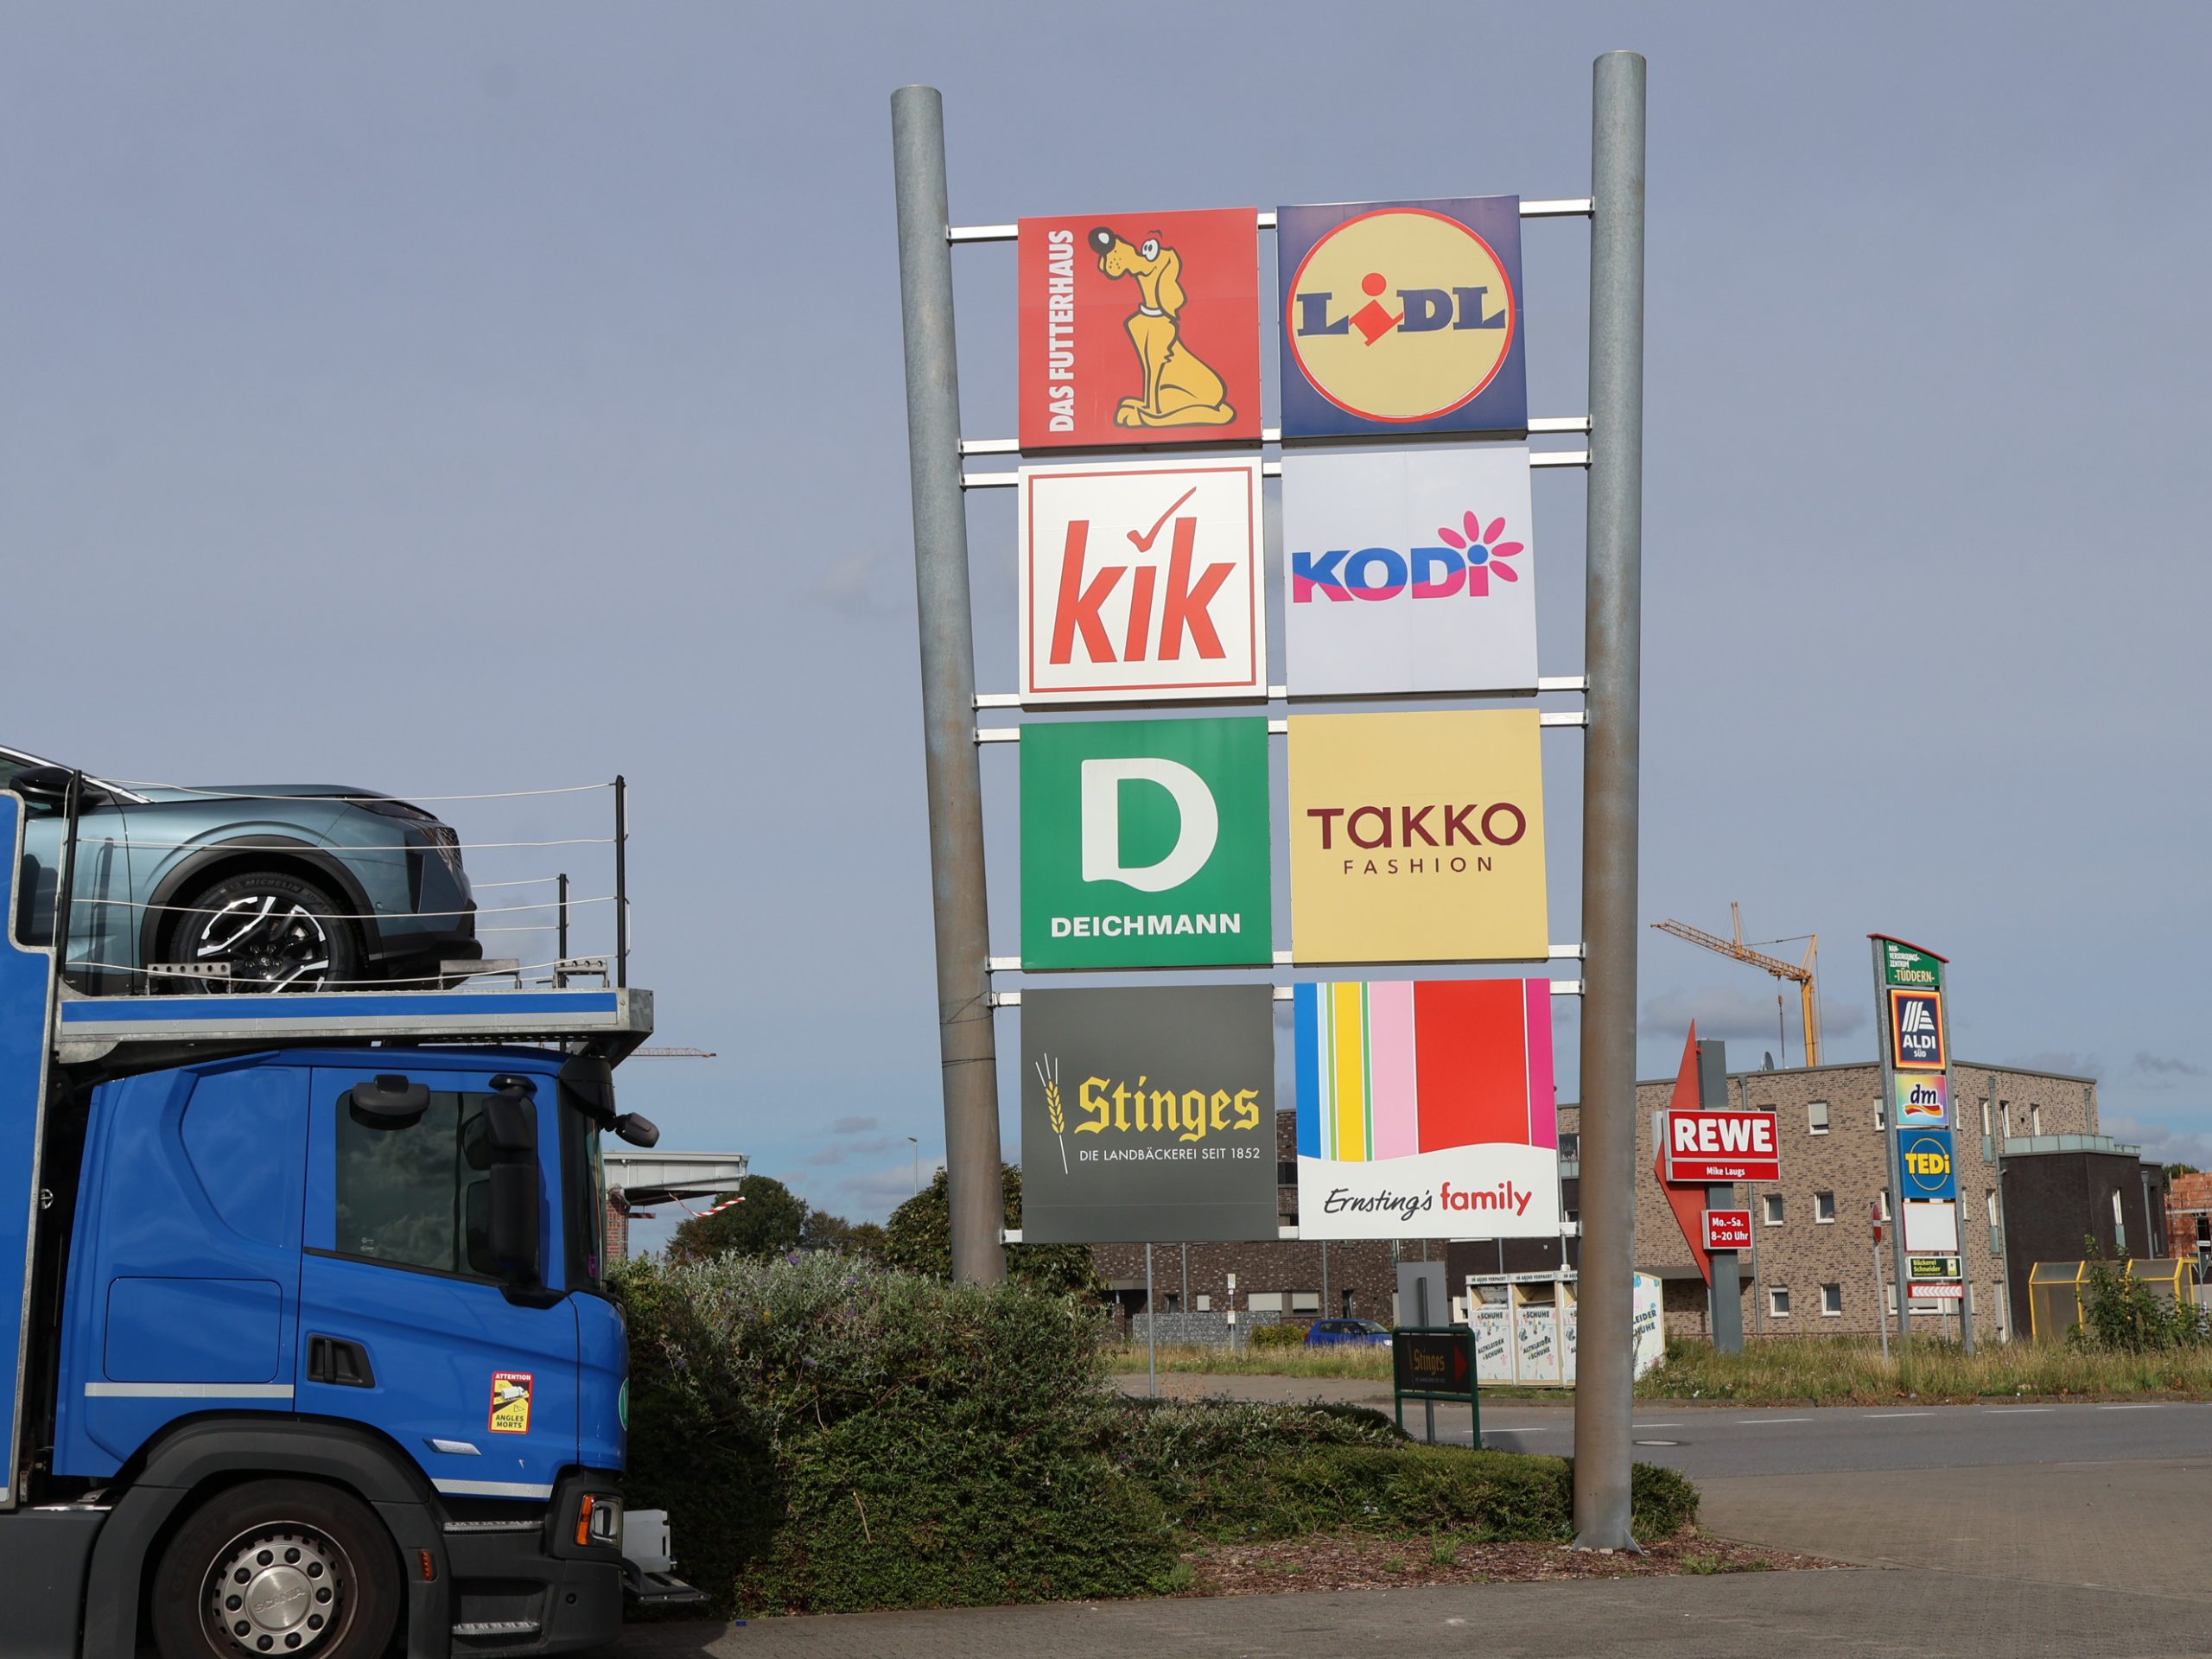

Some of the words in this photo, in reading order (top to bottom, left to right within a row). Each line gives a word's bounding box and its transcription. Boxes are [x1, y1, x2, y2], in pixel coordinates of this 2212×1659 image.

[1049, 230, 1074, 381] FUTTERHAUS
[1049, 386, 1074, 432] DAS
[1081, 757, 1218, 893] D
[1343, 856, 1493, 875] FASHION
[245, 879, 302, 893] MICHELIN
[1051, 913, 1242, 938] DEICHMANN
[1903, 1035, 1936, 1049] ALDI
[1913, 1048, 1927, 1058] SÜD
[1910, 1084, 1937, 1105] dm
[1074, 1076, 1261, 1142] Stinges
[1674, 1118, 1774, 1153] REWE
[1079, 1149, 1099, 1161] DIE
[1103, 1146, 1198, 1161] LANDBÄCKEREI
[1202, 1148, 1226, 1160] SEIT
[1230, 1147, 1261, 1160] 1852
[1707, 1166, 1723, 1176] Mike
[1725, 1167, 1745, 1178] Laugs
[1324, 1187, 1432, 1222] Ernsting's
[1440, 1180, 1533, 1217] family
[1733, 1230, 1749, 1241] Uhr
[1478, 1338, 1504, 1355] ALTKLEIDER
[1523, 1337, 1552, 1354] ALTKLEIDER
[1412, 1348, 1446, 1376] Stinges
[495, 1414, 524, 1422] ANGLES
[255, 1587, 306, 1613] SCANIA
